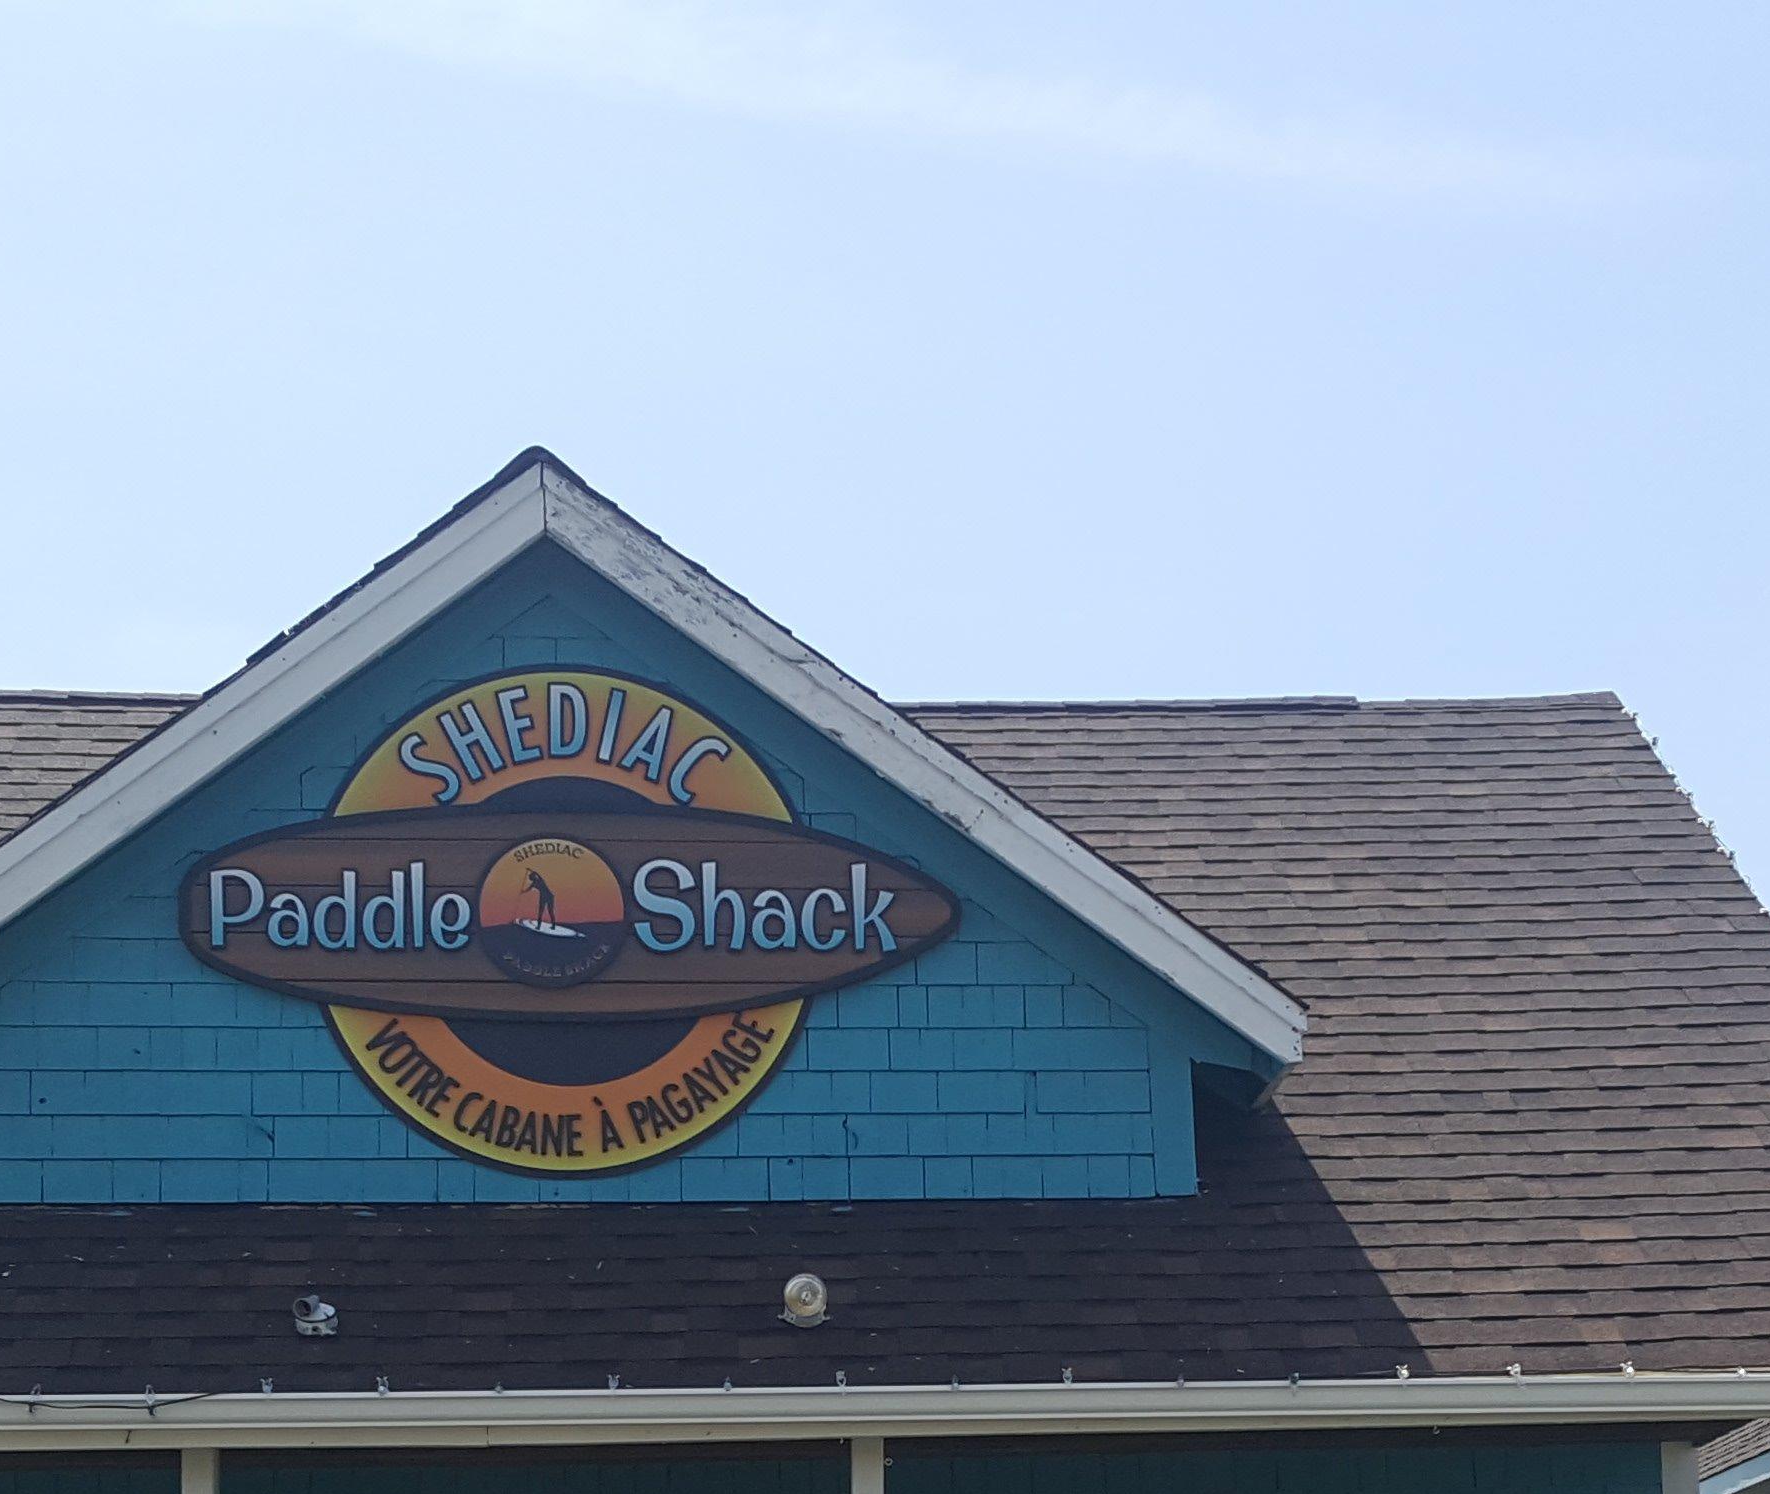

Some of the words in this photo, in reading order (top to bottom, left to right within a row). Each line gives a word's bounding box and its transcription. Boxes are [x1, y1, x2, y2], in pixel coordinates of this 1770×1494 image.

[397, 680, 733, 804] SHEDIAC
[208, 859, 472, 951] Paddle
[632, 857, 899, 954] Shack
[513, 842, 584, 863] SHEDIAC
[364, 1017, 460, 1118] VOTRE
[453, 1090, 583, 1158] CABANE
[595, 1094, 625, 1152] À
[627, 1010, 777, 1145] PAGAYAGE
